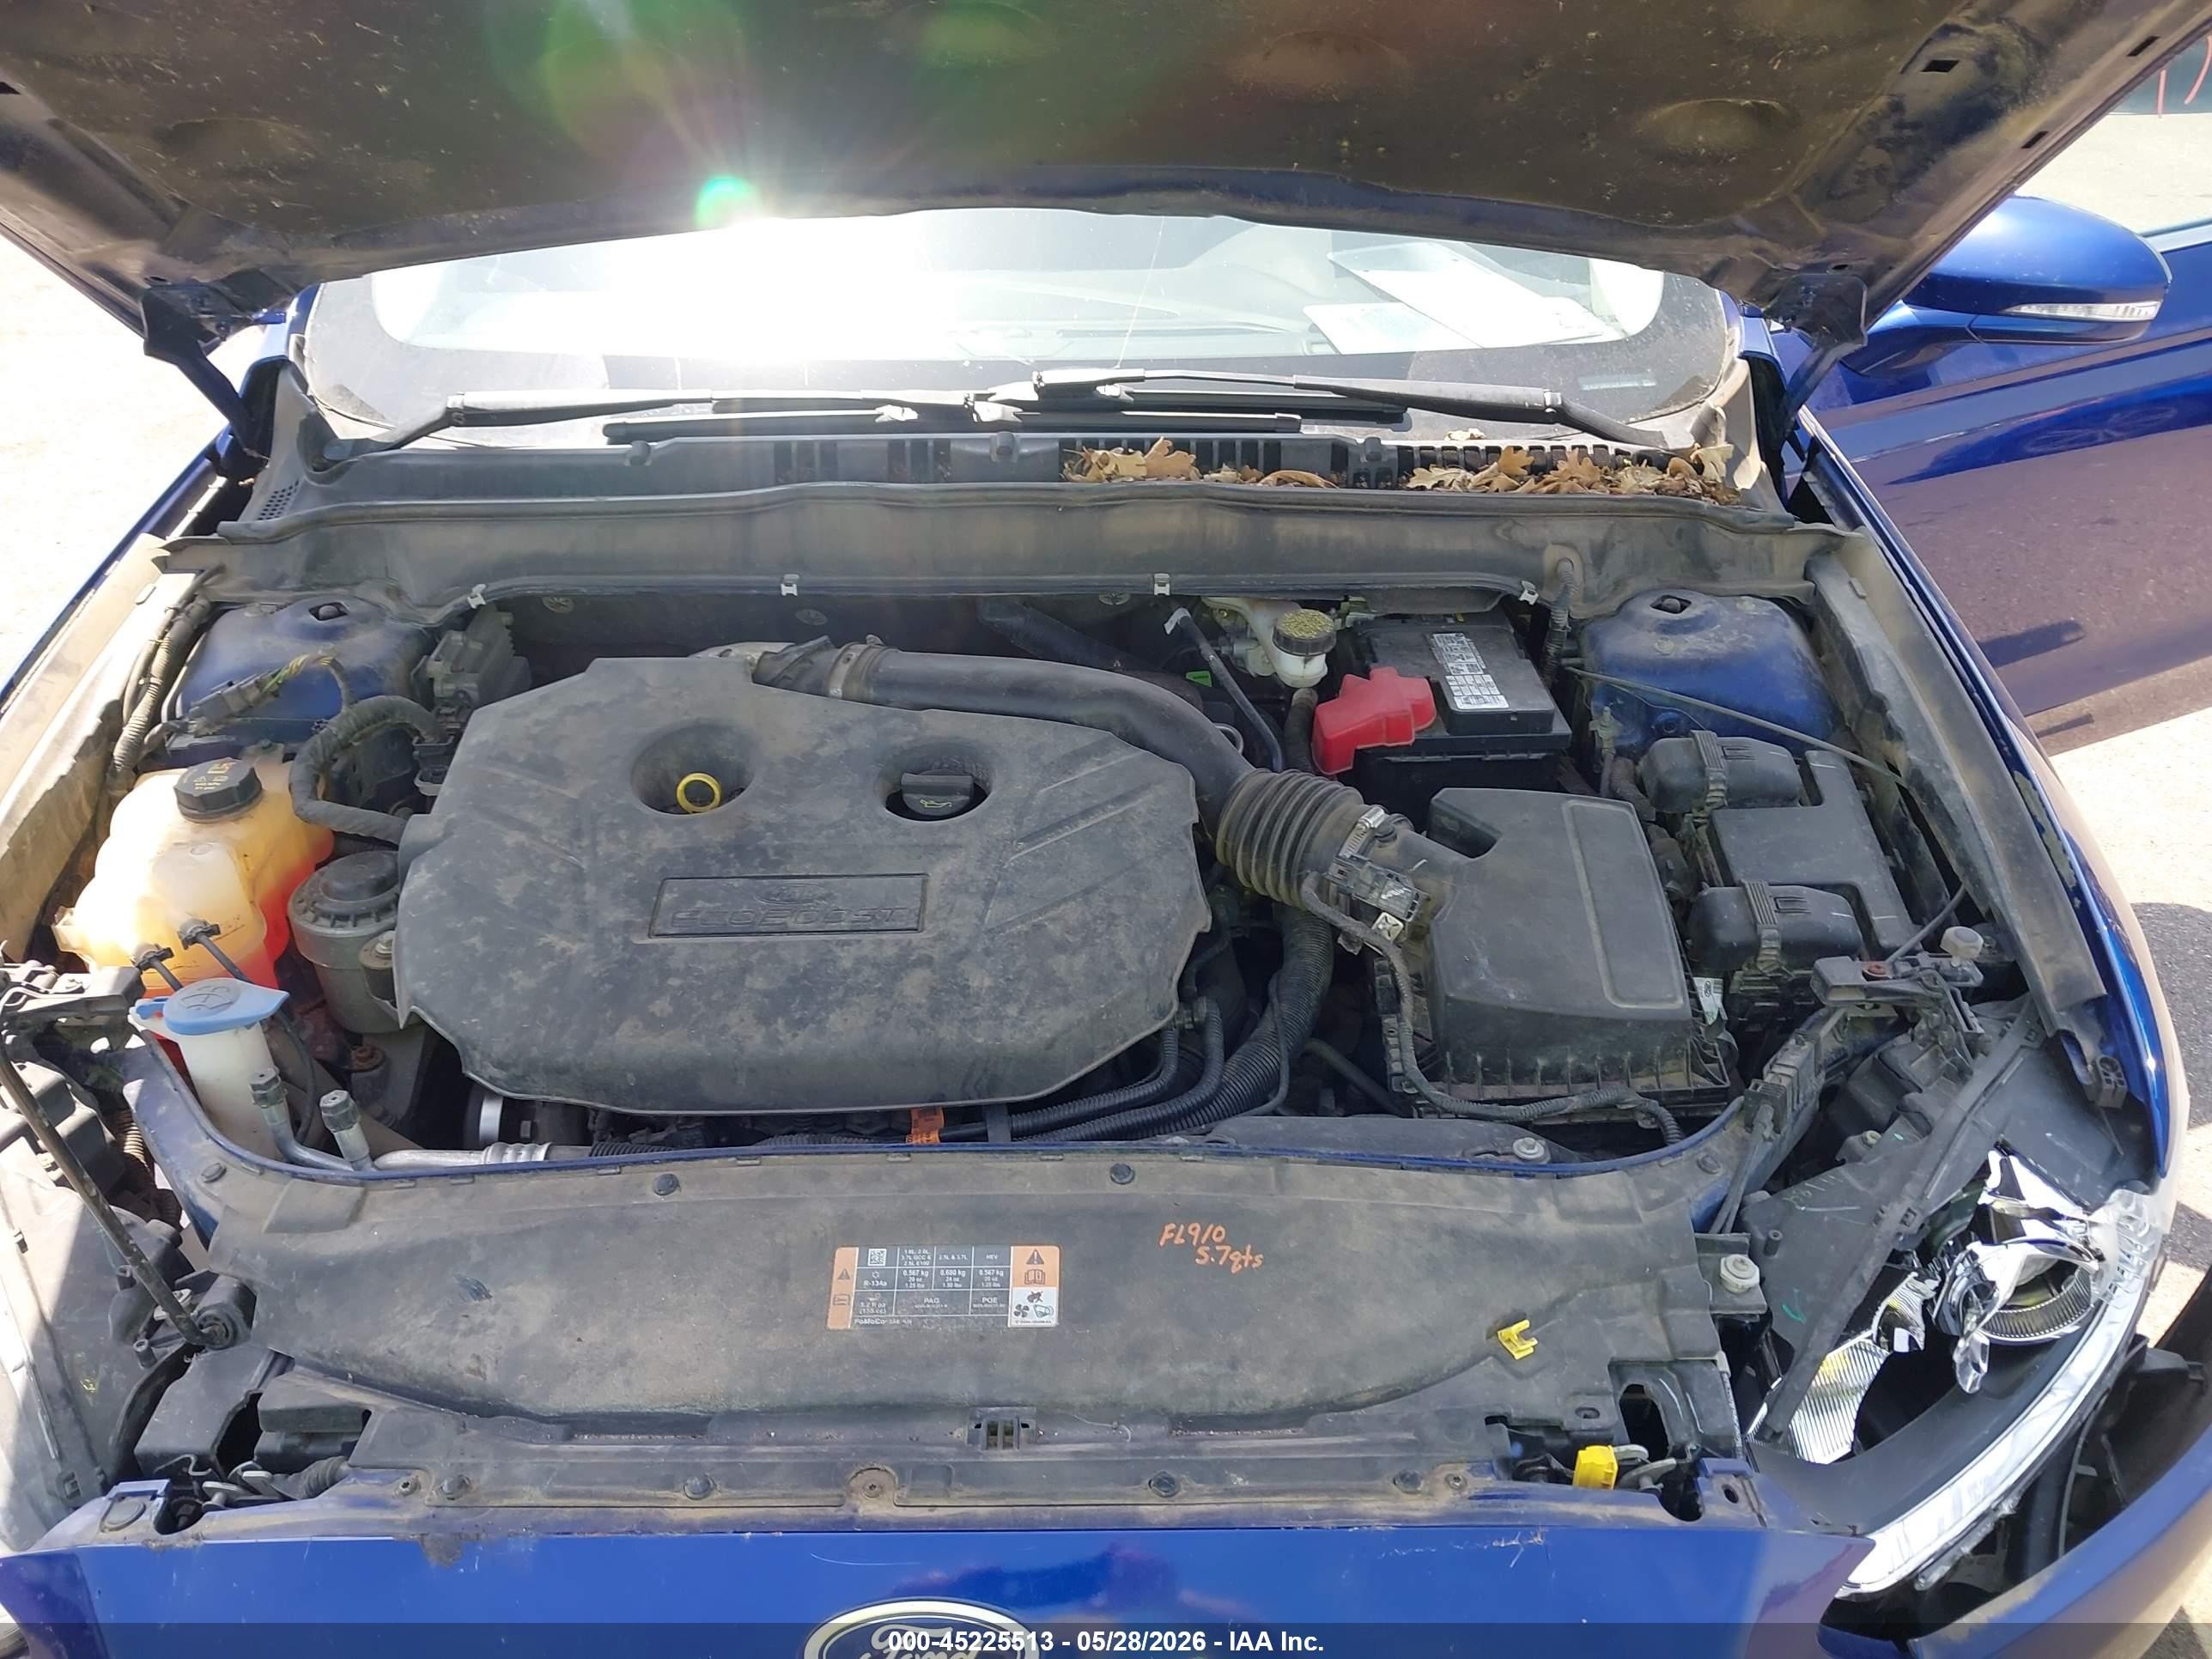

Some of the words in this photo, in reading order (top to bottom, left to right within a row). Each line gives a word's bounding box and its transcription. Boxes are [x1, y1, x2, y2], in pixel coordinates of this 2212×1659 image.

[921, 1269, 929, 1279] kg
[957, 1269, 966, 1278] kg
[996, 1269, 1004, 1278] kg
